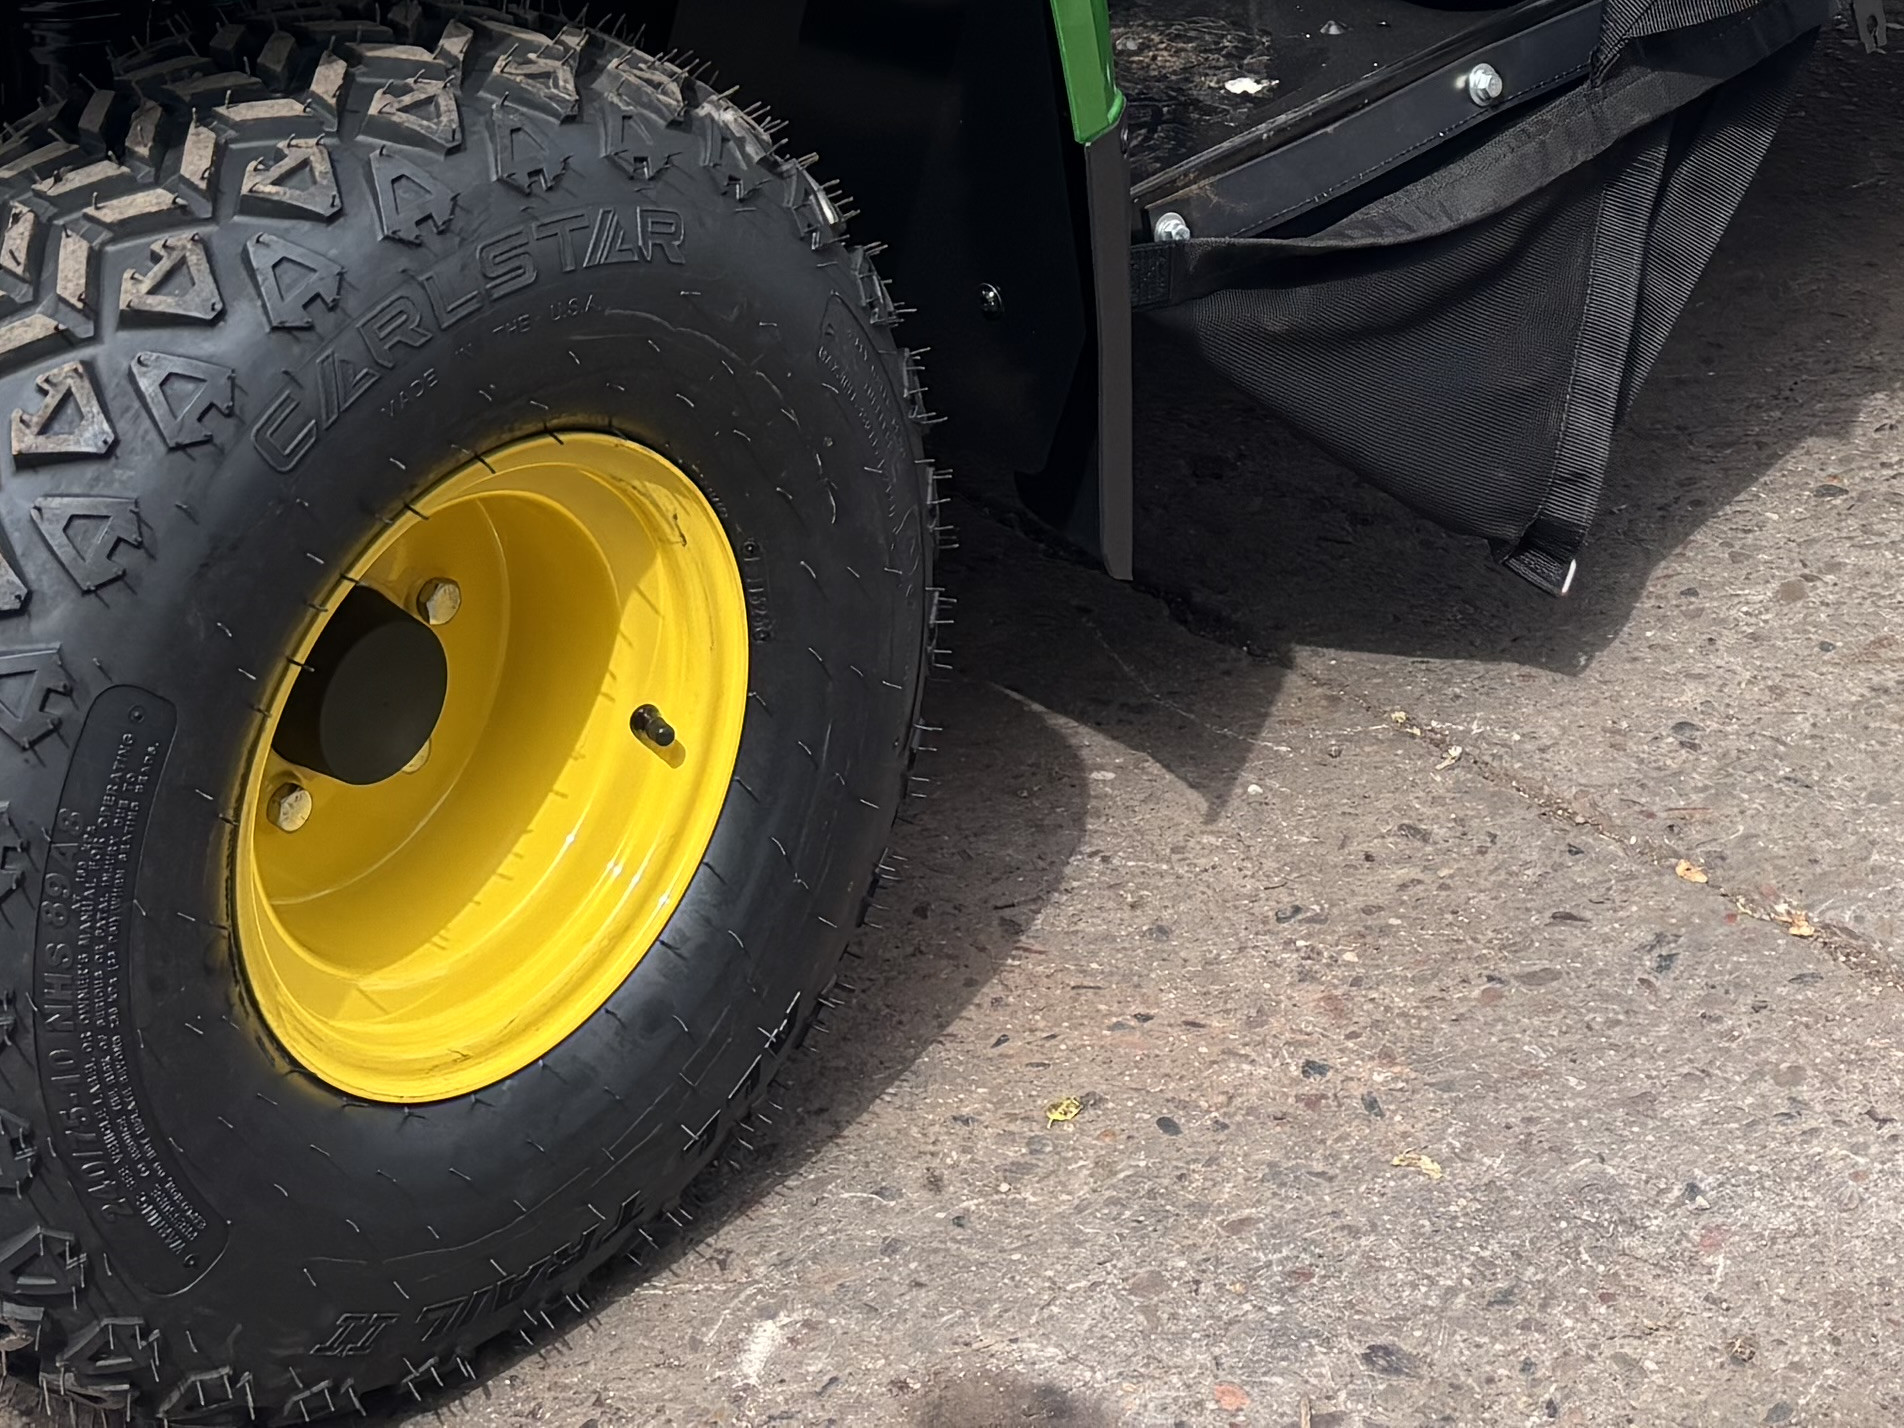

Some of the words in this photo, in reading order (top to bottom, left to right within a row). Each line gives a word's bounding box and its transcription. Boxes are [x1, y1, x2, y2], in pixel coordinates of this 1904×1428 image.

[250, 203, 688, 474] CARLSTAR
[97, 734, 134, 828] OPERATING
[42, 941, 75, 1026] NHS
